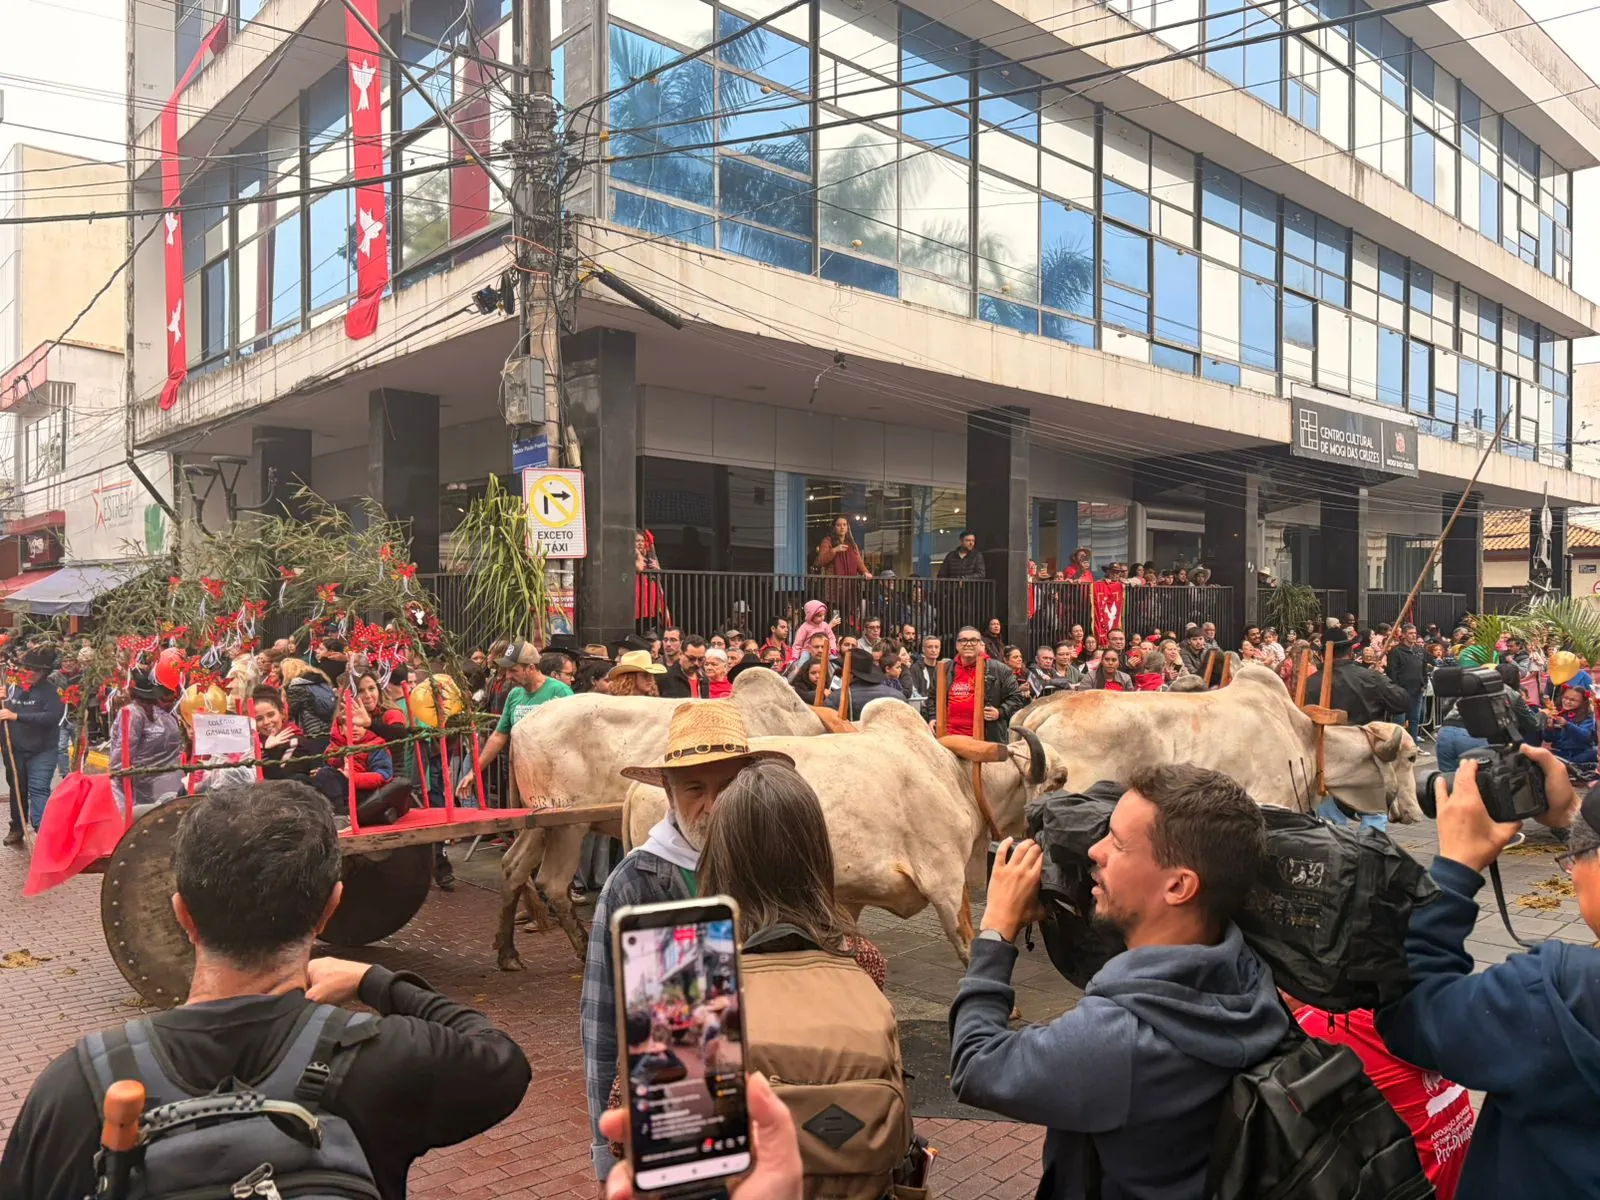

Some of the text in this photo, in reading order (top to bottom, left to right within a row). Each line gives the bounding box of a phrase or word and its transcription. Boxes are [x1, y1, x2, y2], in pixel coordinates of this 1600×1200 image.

[1320, 426, 1374, 449] CENTRO CULTURAL
[1320, 442, 1328, 454] DE
[1329, 443, 1346, 458] MOGI
[1347, 447, 1358, 460] DAS
[1359, 450, 1380, 464] CRUZES
[537, 530, 573, 540] EXCETO
[545, 541, 568, 552] TÁXI
